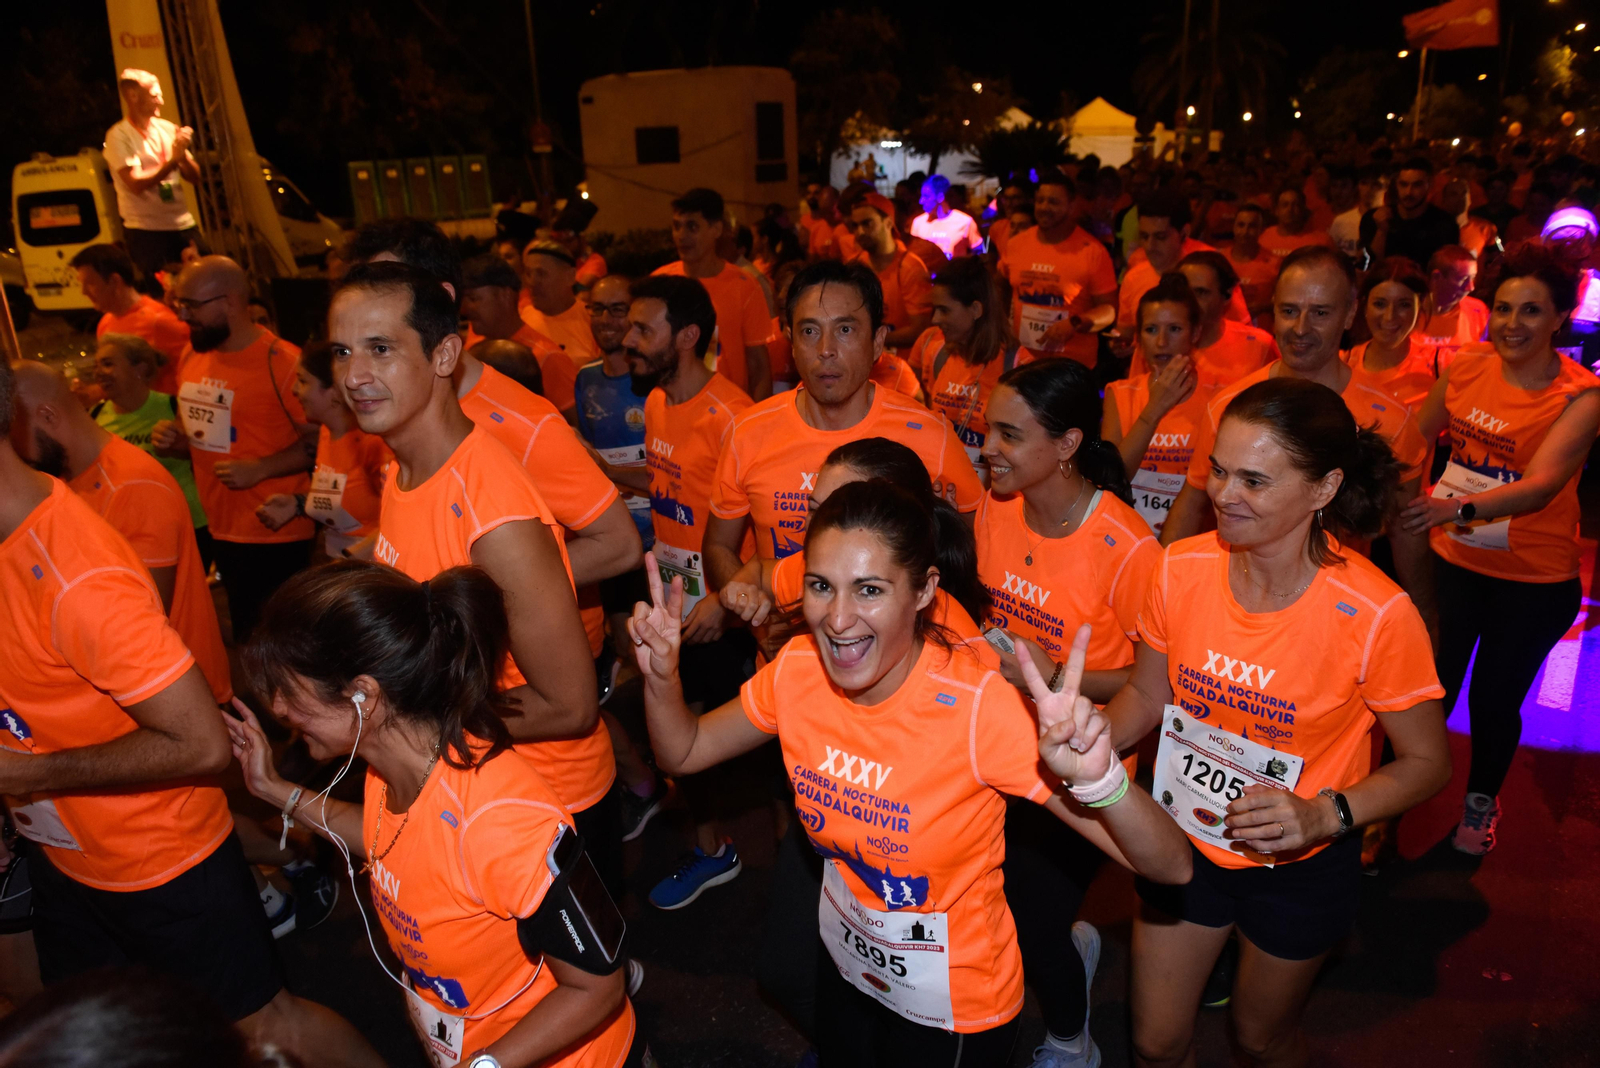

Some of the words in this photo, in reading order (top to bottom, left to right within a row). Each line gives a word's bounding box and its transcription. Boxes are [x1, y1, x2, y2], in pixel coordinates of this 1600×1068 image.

[1029, 321, 1050, 333] 184
[188, 406, 214, 424] 5572
[1466, 407, 1509, 433] XXXV
[651, 436, 674, 458] XXXV
[1142, 494, 1174, 511] 164
[375, 532, 400, 567] XXXV
[662, 568, 688, 590] 113
[1001, 570, 1051, 607] XXXV
[1019, 600, 1065, 627] NOCTURNA
[1201, 649, 1276, 690] XXXV
[1178, 663, 1222, 691] CARRERA
[1228, 684, 1297, 712] NOCTURNA
[1182, 678, 1294, 725] GUADALQUIVIR
[817, 745, 894, 791] XXXV
[1183, 753, 1246, 802] 1205
[794, 765, 838, 793] CARRERA
[842, 786, 911, 815] NOCTURNA
[1175, 777, 1187, 788] MARI
[1187, 785, 1208, 802] CARMEN
[796, 781, 910, 834] GUADALQUIVIR
[840, 920, 908, 977] 7895
[906, 1008, 946, 1024] Cruzcampo
